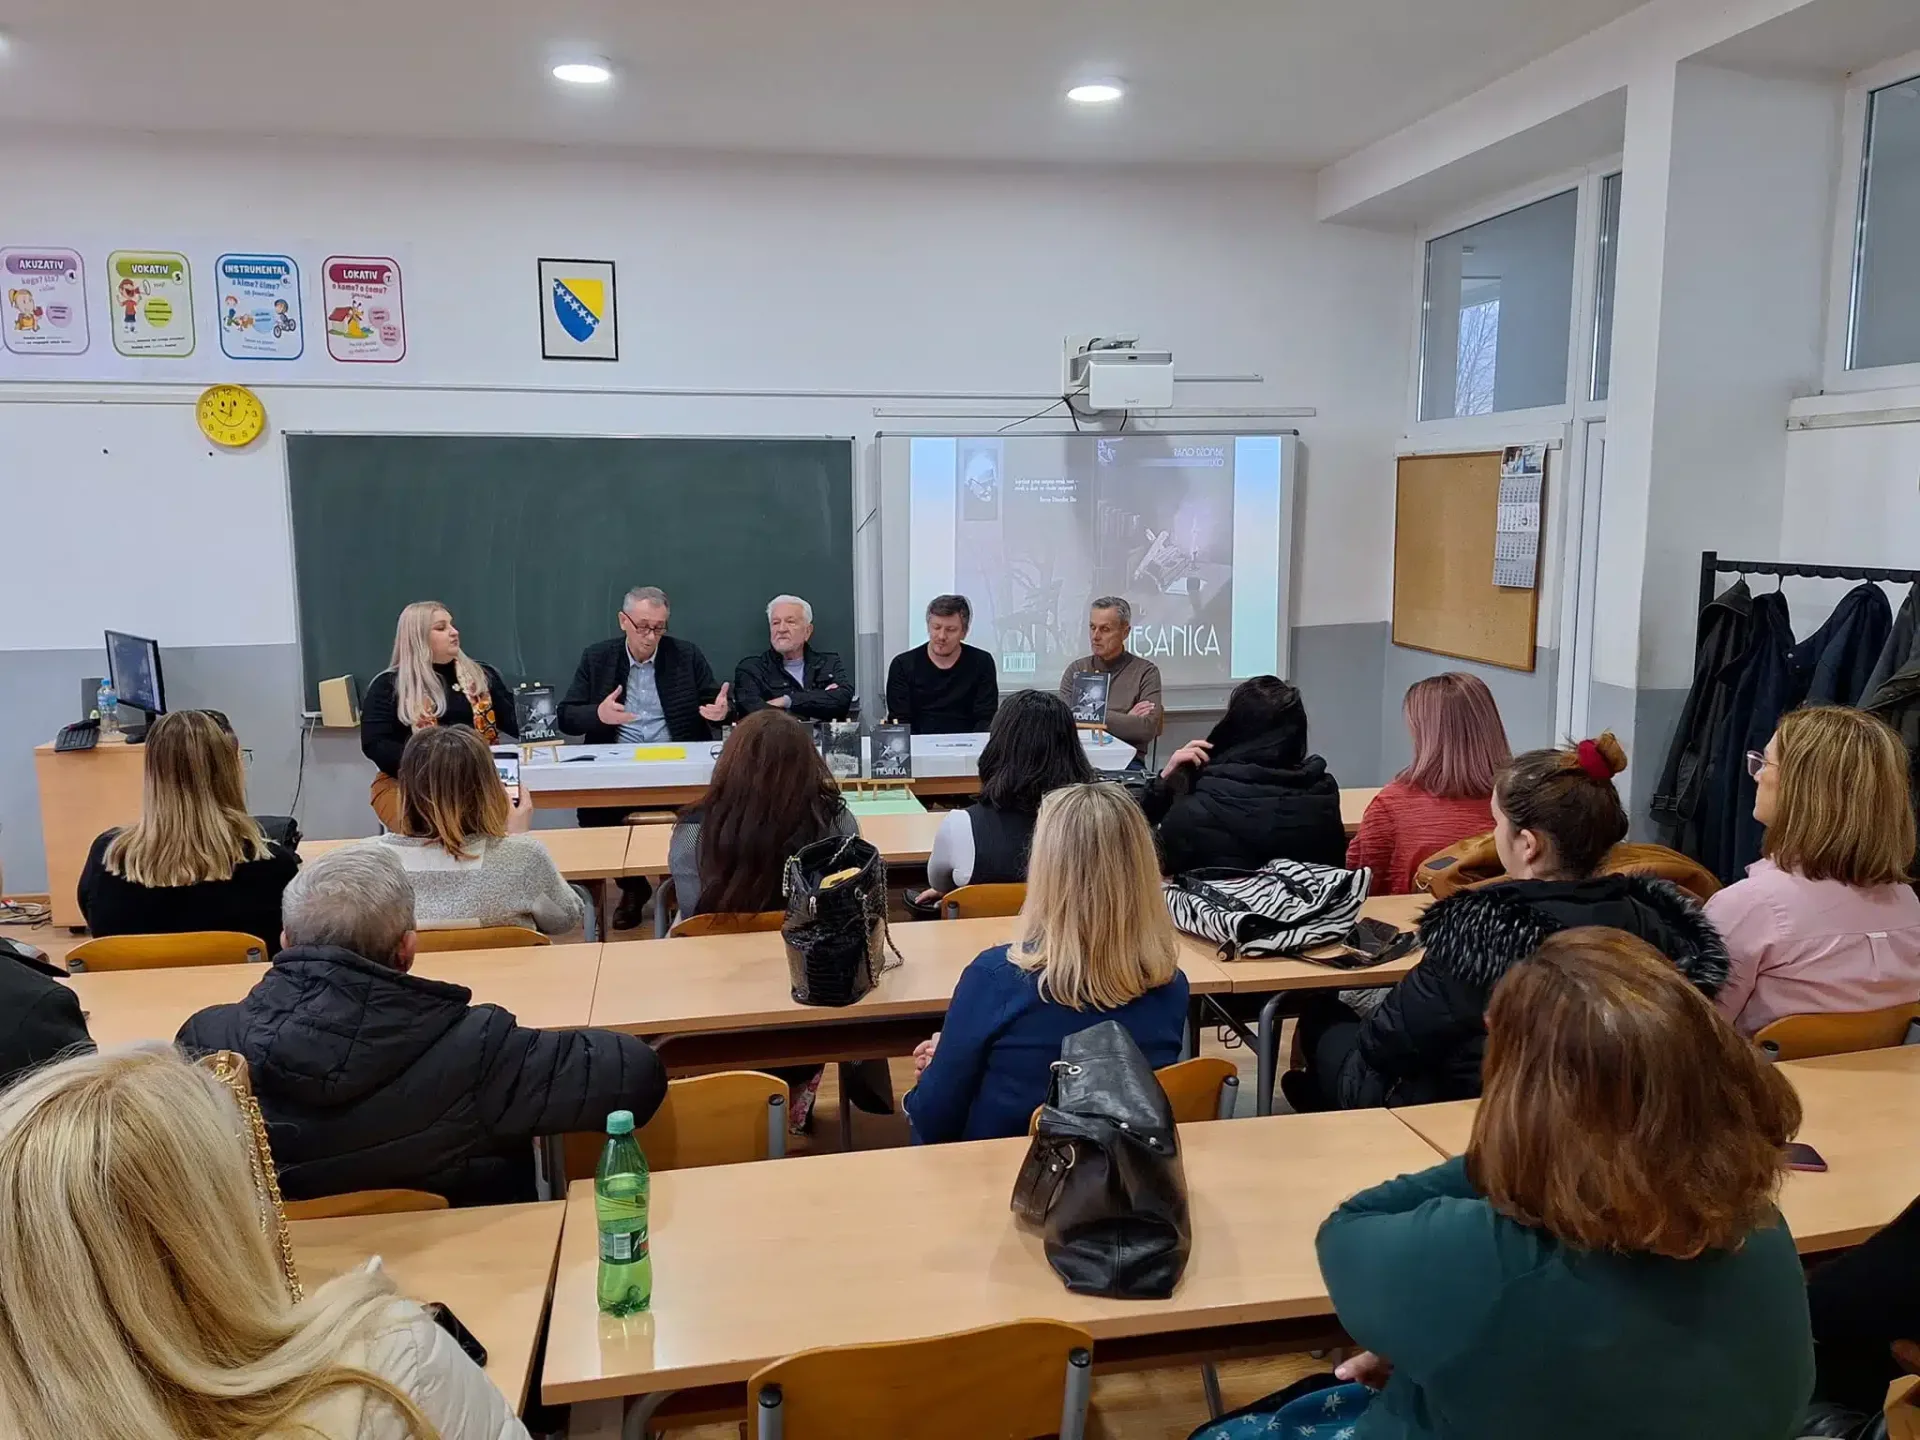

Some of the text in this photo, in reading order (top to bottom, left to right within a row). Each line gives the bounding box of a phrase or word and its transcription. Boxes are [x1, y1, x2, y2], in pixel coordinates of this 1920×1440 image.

[19, 259, 64, 270] AKUZATIV
[131, 264, 169, 274] VOKATIV
[225, 264, 287, 275] INSTRUMENTAL
[343, 269, 378, 280] LOKATIV
[212, 391, 219, 399] 11
[223, 388, 231, 396] 12
[202, 411, 208, 419] 9
[252, 410, 258, 418] 3
